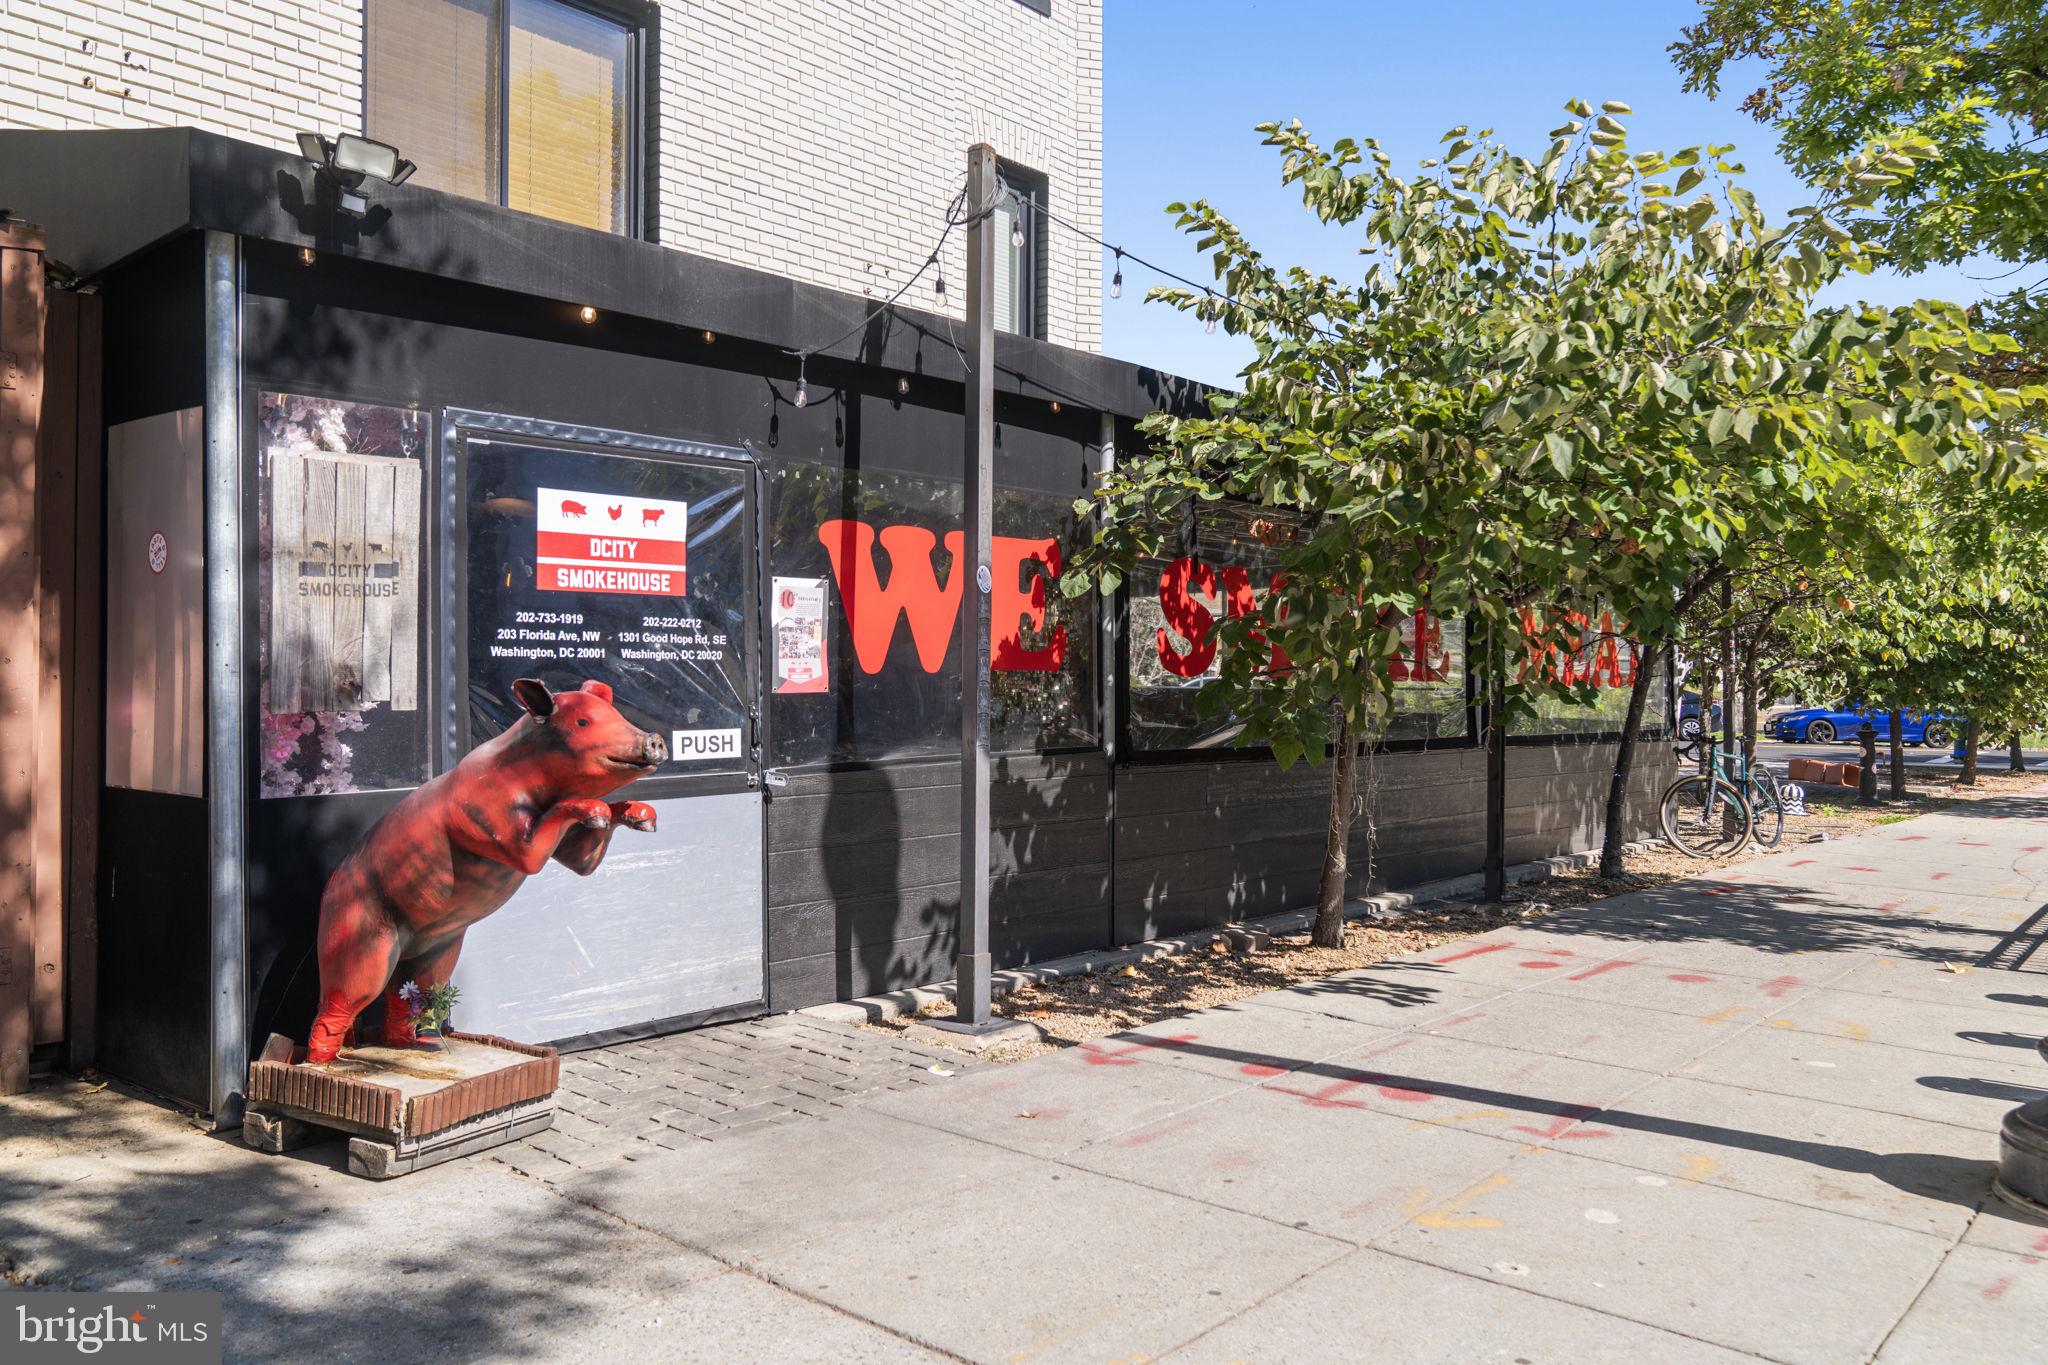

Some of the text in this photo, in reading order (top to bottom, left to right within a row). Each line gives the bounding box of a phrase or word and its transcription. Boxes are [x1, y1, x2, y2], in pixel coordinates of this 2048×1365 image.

[590, 538, 638, 559] DCITY
[557, 568, 671, 592] SMOKEHOUSE
[299, 582, 399, 598] SMOKEHOUSE
[818, 519, 1066, 675] WE
[516, 611, 584, 624] 202-733-1919
[643, 616, 702, 628] 202-222-0212
[497, 629, 600, 643] 203 Florida Ave, NW
[618, 632, 727, 646] 1301 Good Hope Rd, SE
[490, 646, 605, 660] Washington, DC 20001
[621, 649, 723, 661] Washington, DC 20020
[681, 734, 734, 754] PUSH
